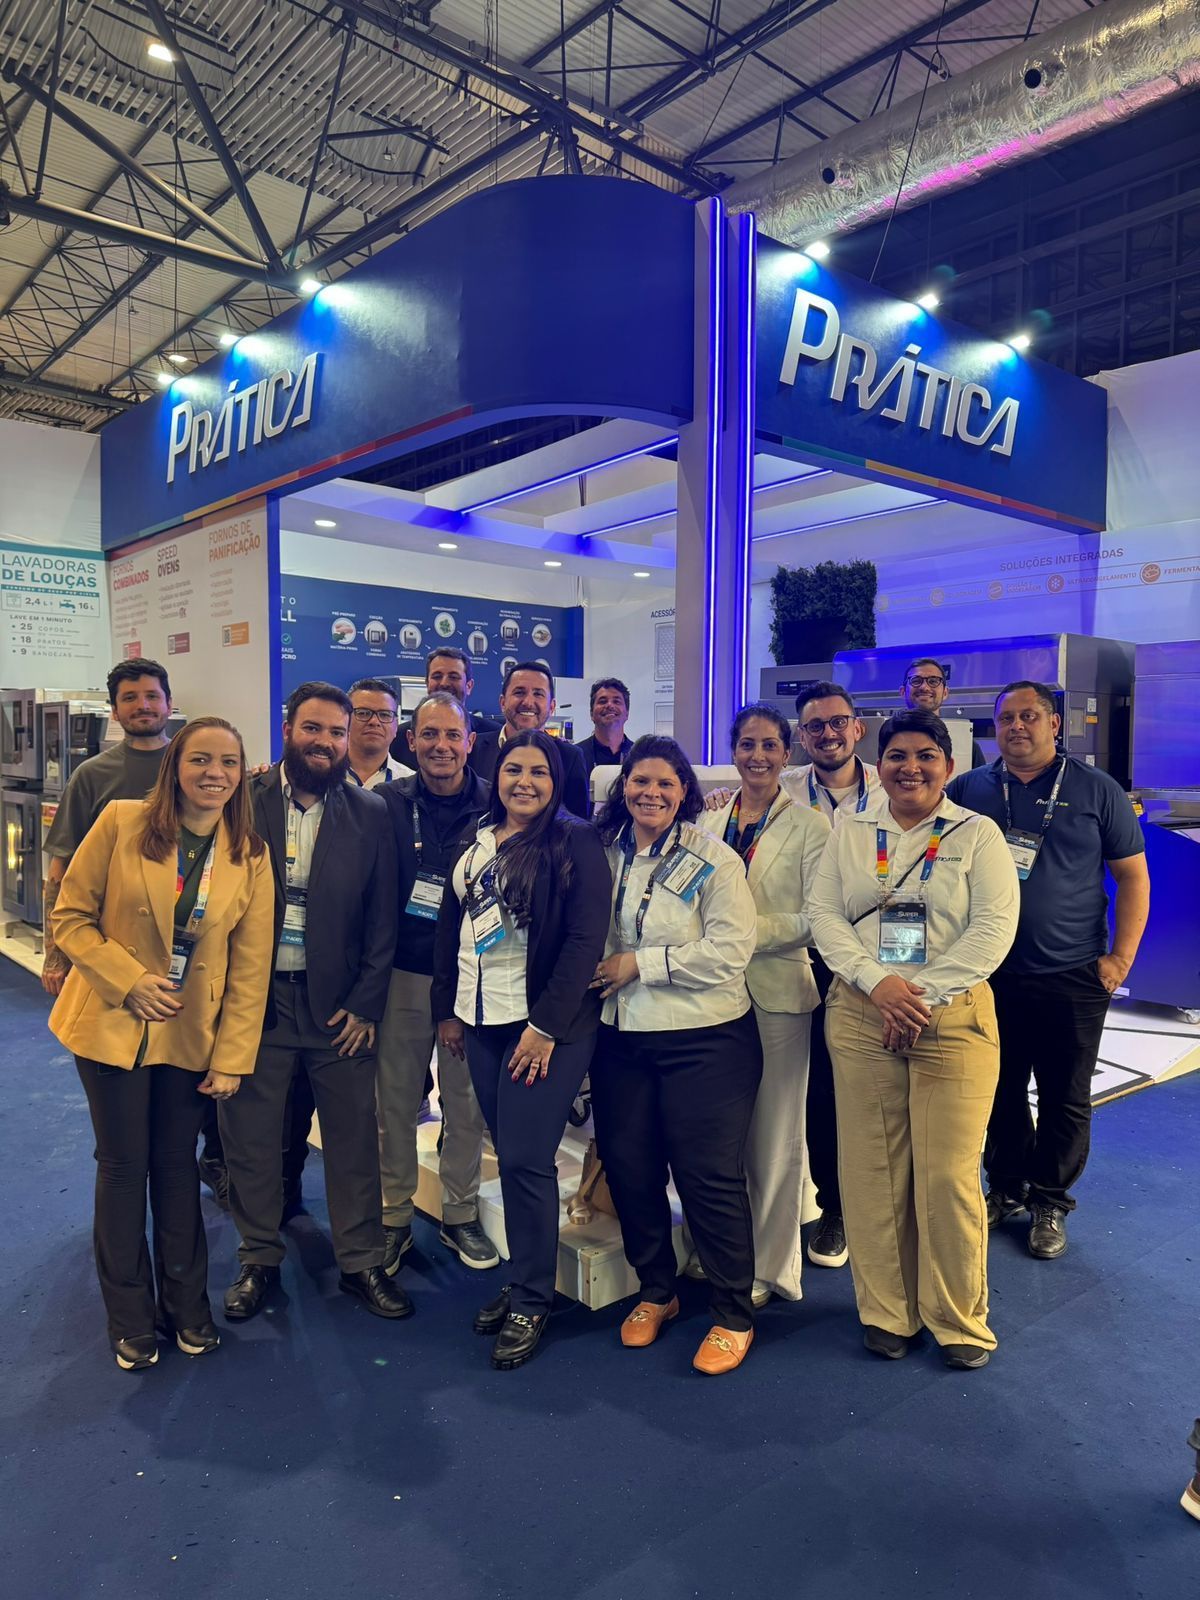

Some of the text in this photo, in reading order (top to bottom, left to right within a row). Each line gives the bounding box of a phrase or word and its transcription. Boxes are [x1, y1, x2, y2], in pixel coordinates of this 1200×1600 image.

[779, 288, 1020, 456] PRÁTICA
[166, 351, 318, 483] PRÁTICA
[208, 519, 252, 545] FORNOS DE
[157, 544, 178, 562] SPEED
[208, 532, 261, 562] PANIFICAÇÃO
[2, 554, 97, 574] LAVADORAS
[157, 559, 180, 578] OVENS
[1000, 548, 1124, 572] SOLUÇÕES INTEGRADAS
[2, 569, 97, 588] DE LOUÇAS
[113, 569, 150, 591] COMBINADOS
[25, 597, 41, 606] 2,4
[20, 622, 33, 631] 25
